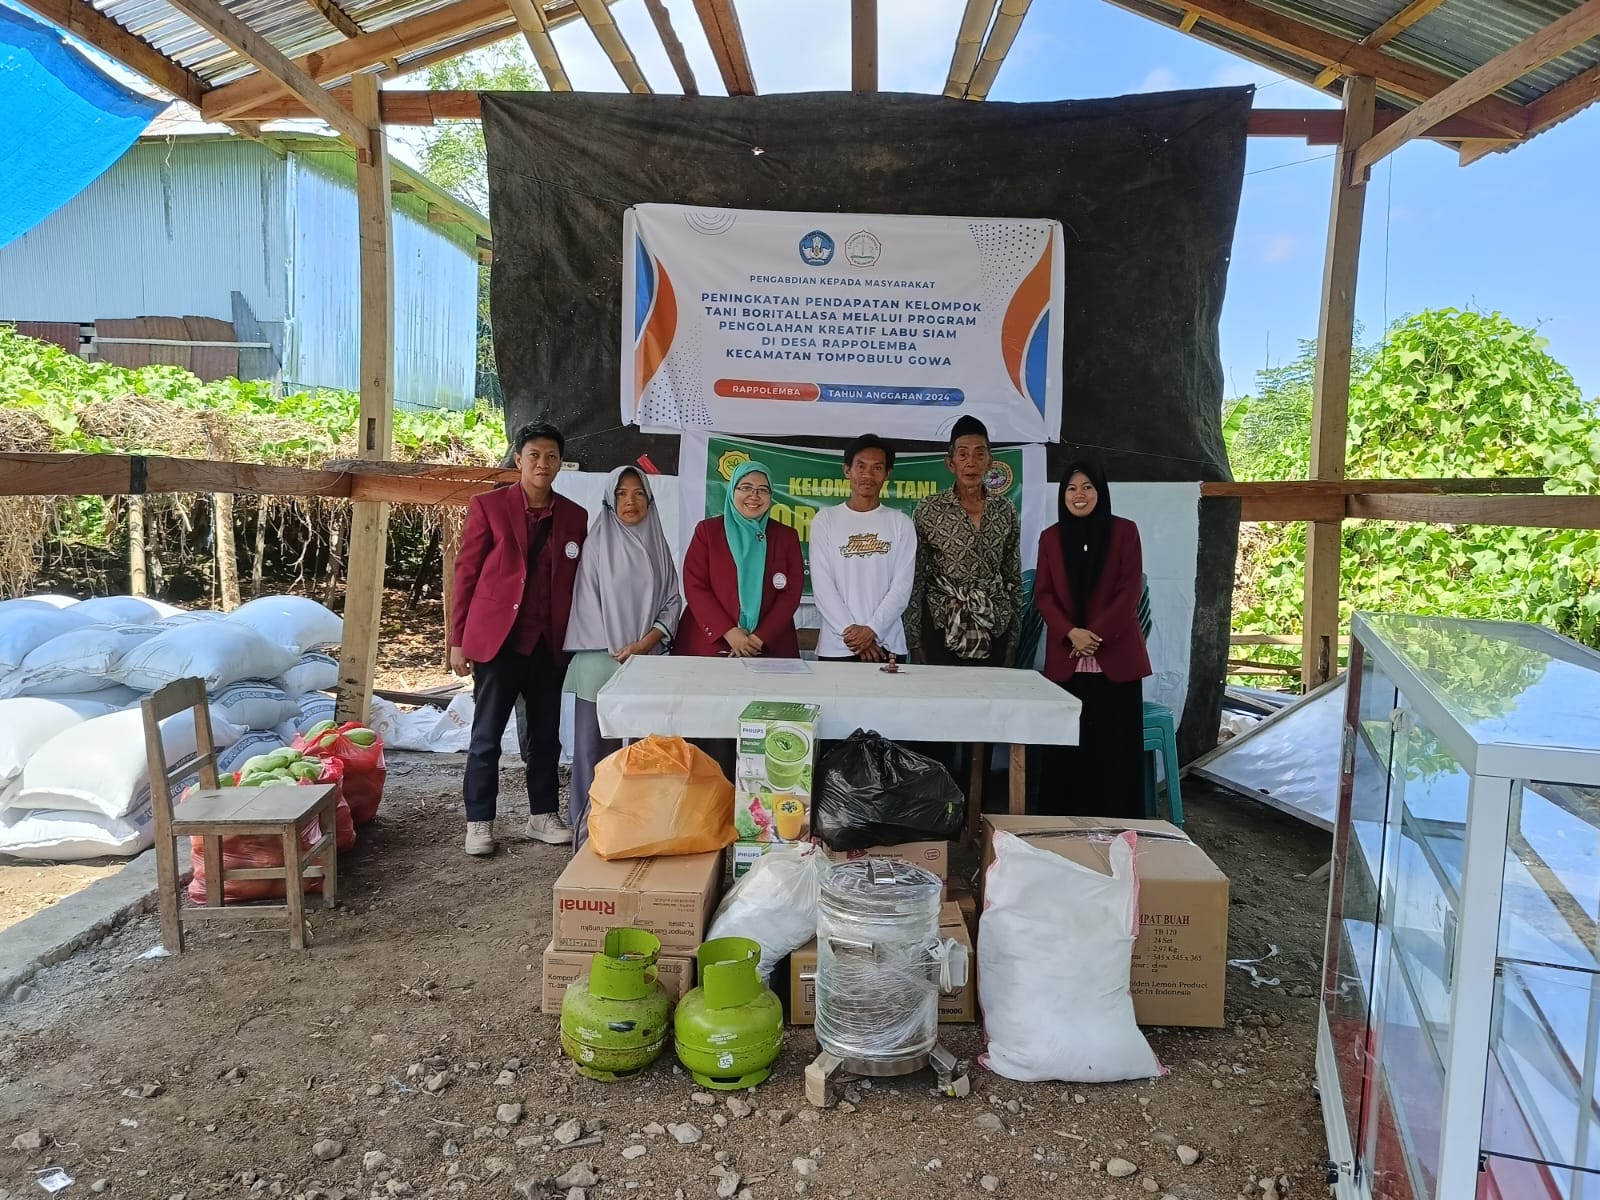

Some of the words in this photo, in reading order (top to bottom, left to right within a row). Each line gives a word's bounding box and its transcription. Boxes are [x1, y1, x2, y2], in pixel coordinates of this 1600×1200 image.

[750, 275, 816, 284] PENGABDIAN
[820, 277, 861, 286] KEPADA
[865, 279, 936, 289] MASYARAKAT
[701, 293, 800, 306] PENINGKATAN
[805, 297, 899, 309] PENDAPATAN
[905, 300, 982, 312] KELOMPOK
[705, 307, 737, 316] TANI
[742, 308, 837, 321] BORITALLASA
[842, 312, 902, 323] MELALUI
[907, 314, 976, 326] PROGRAM
[720, 321, 813, 333] PENGOLAHAN
[818, 324, 877, 336] KREATIF
[881, 327, 918, 337] LABU
[922, 328, 957, 339] SIAM
[762, 336, 775, 346] DI
[781, 337, 817, 348] DESA
[822, 338, 917, 351] RAPPOLEMBA
[726, 349, 811, 361] KECAMATAN
[816, 352, 903, 364] TOMPOBULU
[908, 355, 952, 366] GOWA
[732, 385, 801, 396] RAPPOLEMBA
[828, 389, 863, 398] TAHUN
[865, 391, 923, 401] ANGGARAN
[925, 393, 950, 401] 2024
[789, 477, 889, 498] KELOMK
[896, 480, 937, 499] TANI
[559, 898, 616, 915] Rinnai
[1139, 914, 1161, 924] PAT
[1163, 915, 1189, 924] BUAH
[547, 974, 573, 982] Kompor
[1155, 988, 1191, 996] Indonesia
